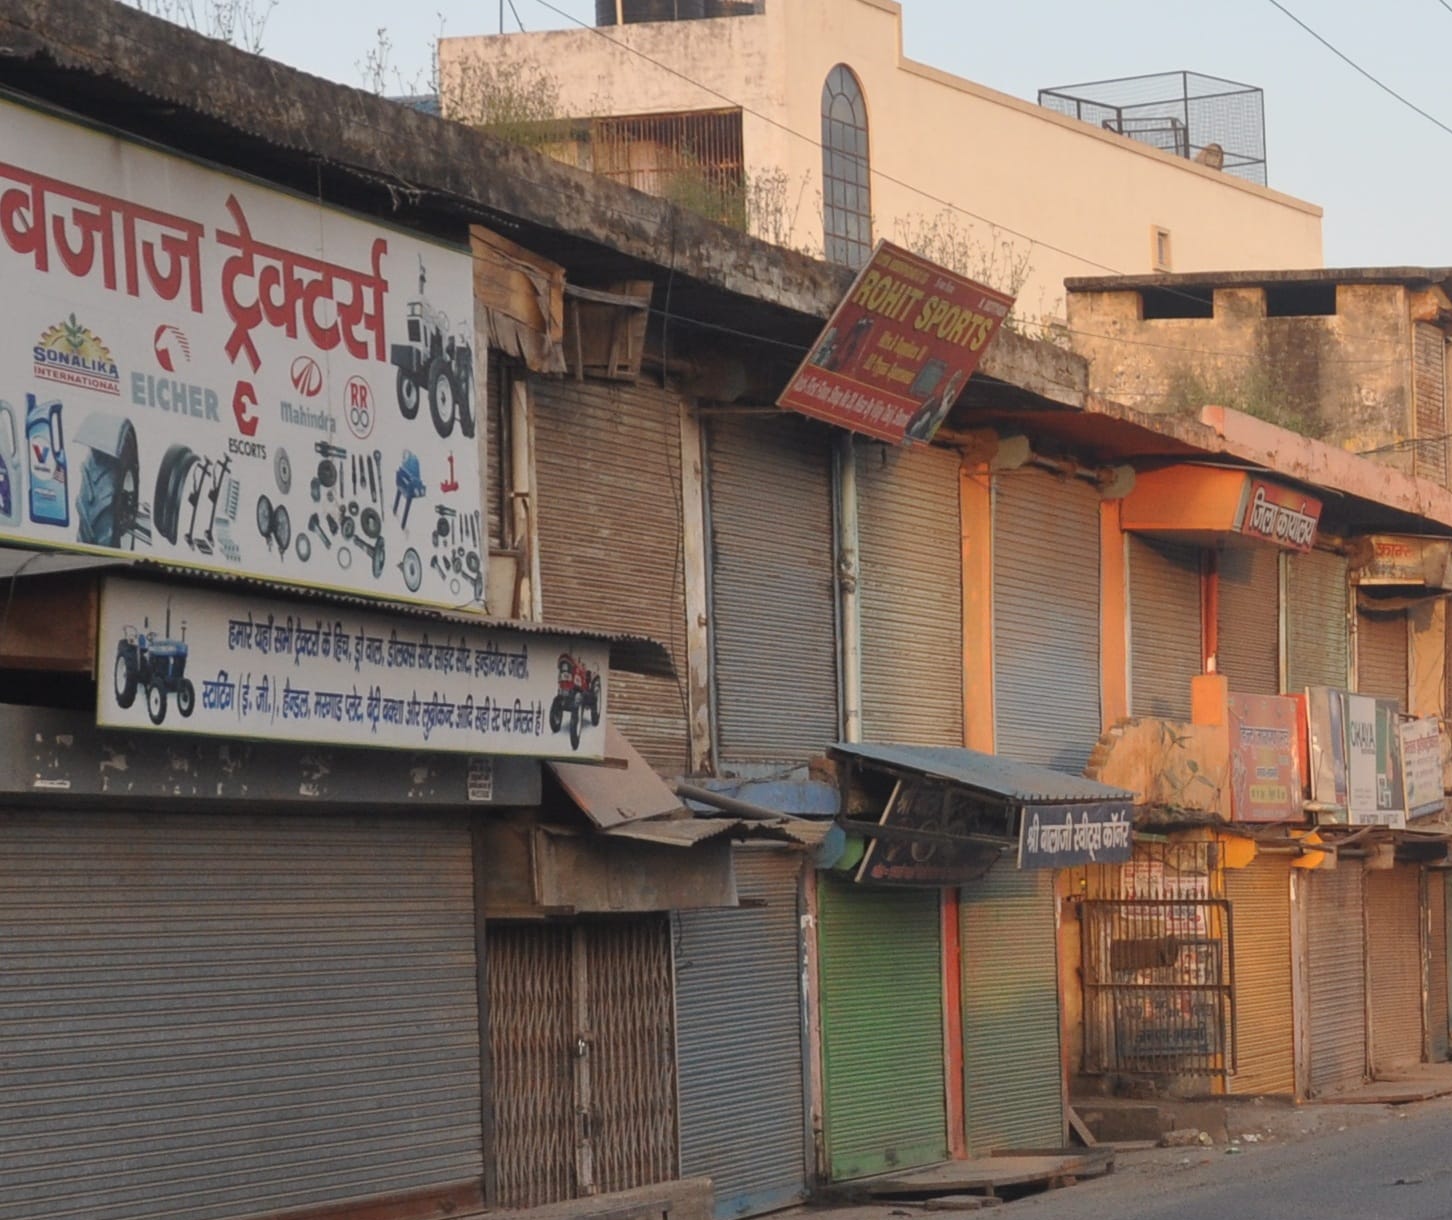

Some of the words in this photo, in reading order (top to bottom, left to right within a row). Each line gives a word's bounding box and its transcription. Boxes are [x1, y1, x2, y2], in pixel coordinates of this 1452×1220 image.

[0, 162, 204, 314] बजाज
[854, 270, 924, 321] ROHIT
[914, 297, 992, 351] SPORTS
[33, 345, 119, 379] SONALIKA
[34, 366, 120, 392] INTERNATIONAL
[131, 372, 220, 422] EICHER
[280, 401, 336, 434] Mahindra
[228, 437, 267, 460] ESCORTS
[1250, 486, 1278, 534] जिला
[1276, 502, 1317, 545] कार्यालय
[406, 689, 421, 726] और
[1027, 813, 1040, 854] श्री
